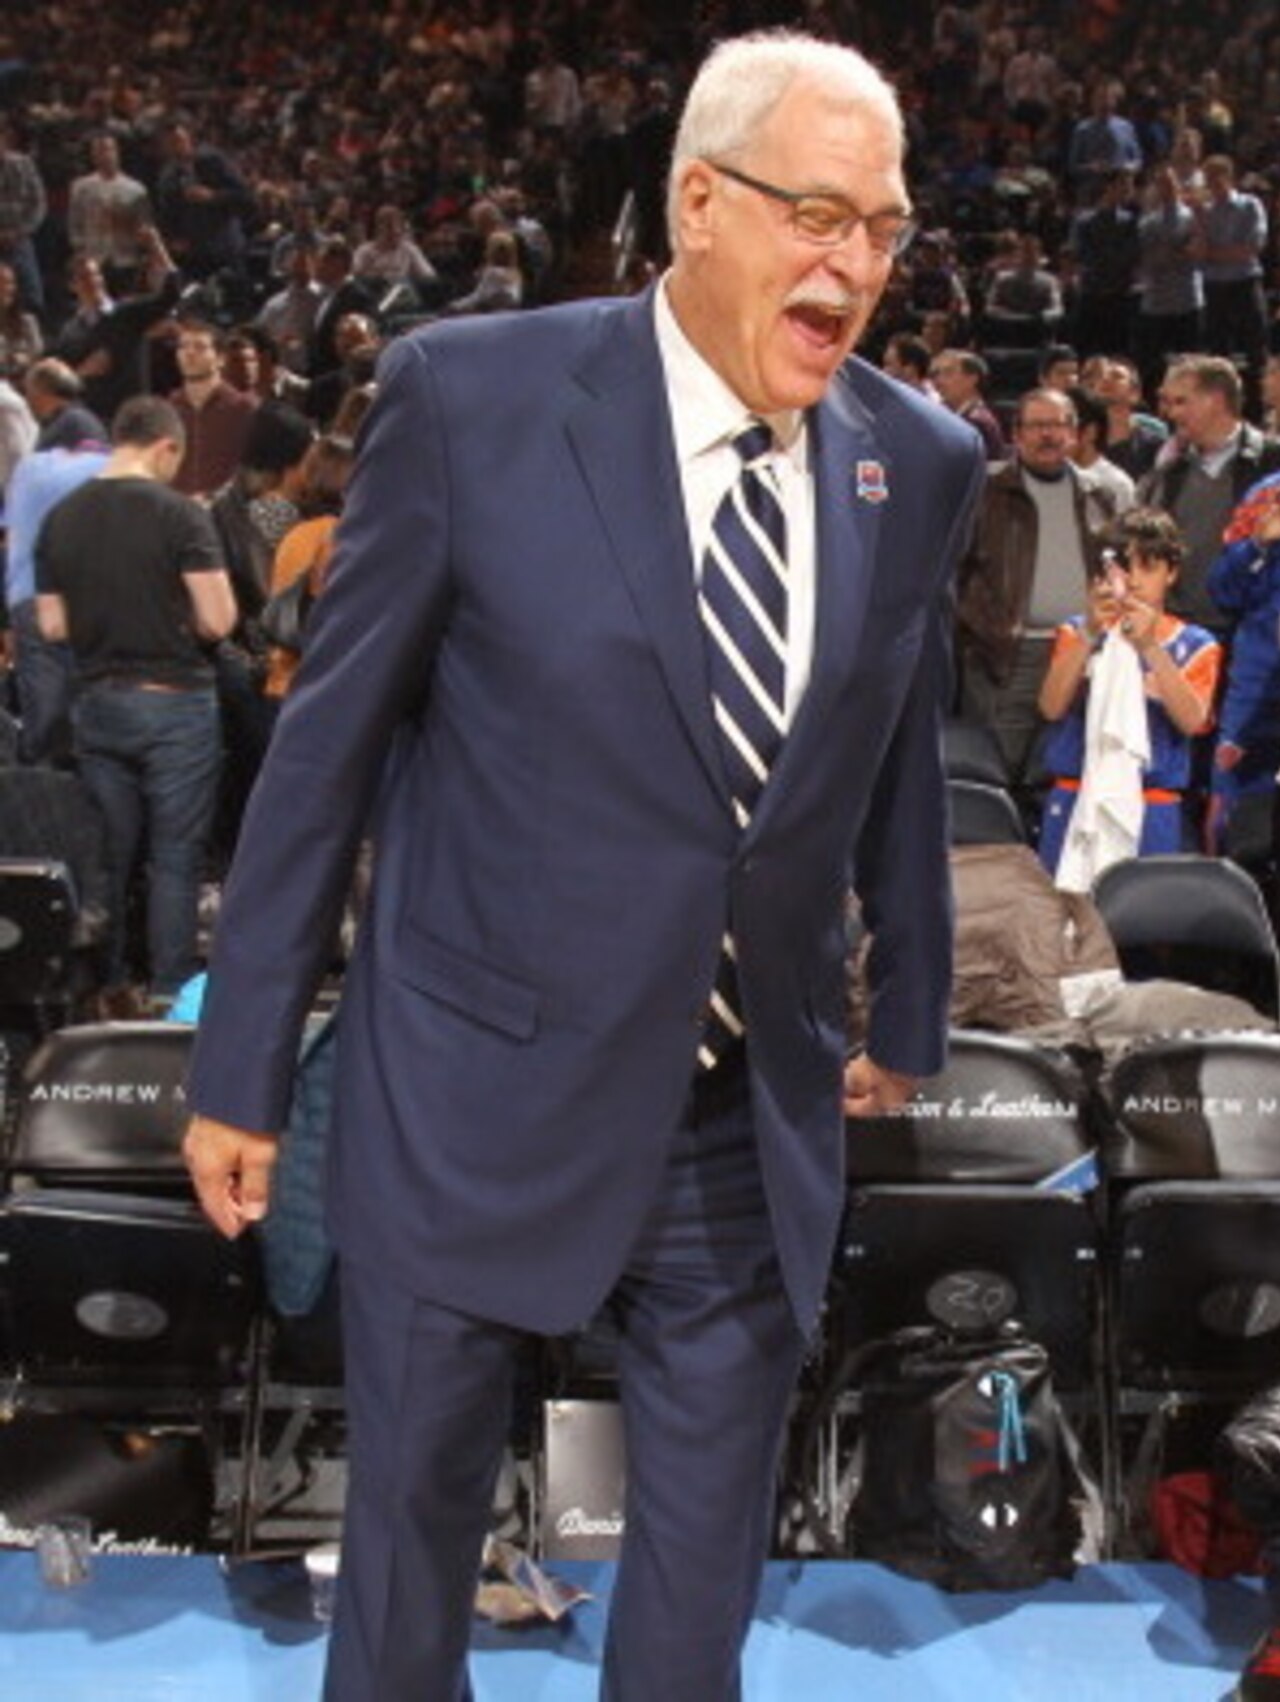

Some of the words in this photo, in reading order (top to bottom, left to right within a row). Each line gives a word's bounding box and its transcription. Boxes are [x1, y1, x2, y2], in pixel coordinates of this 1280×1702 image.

[29, 1084, 161, 1103] ANDREW
[946, 1098, 963, 1118] &
[1123, 1096, 1243, 1117] ANDREW
